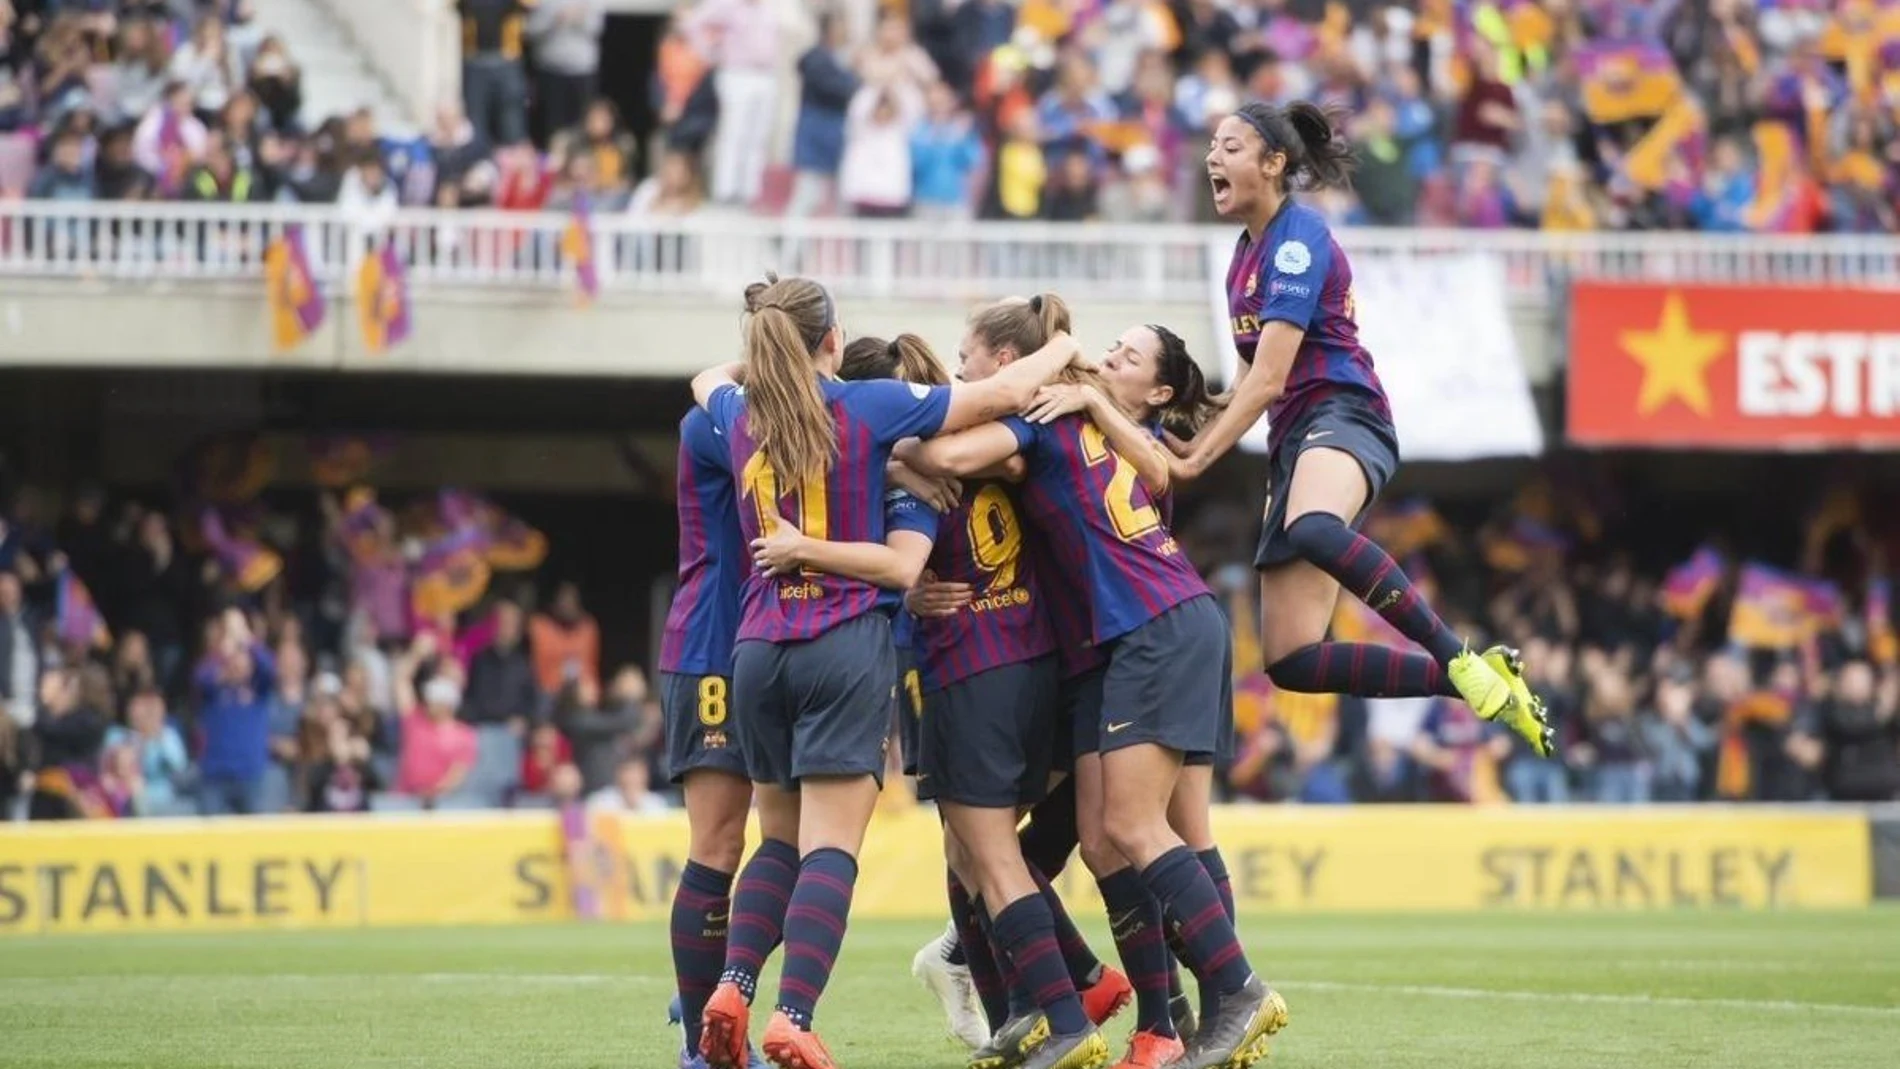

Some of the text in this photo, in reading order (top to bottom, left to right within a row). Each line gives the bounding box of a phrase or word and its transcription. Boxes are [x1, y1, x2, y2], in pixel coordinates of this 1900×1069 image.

[1079, 420, 1162, 543] 2
[966, 485, 1022, 592] 9
[698, 675, 727, 726] 8
[0, 859, 348, 924] STANLEY
[1480, 846, 1793, 907] STANLEY
